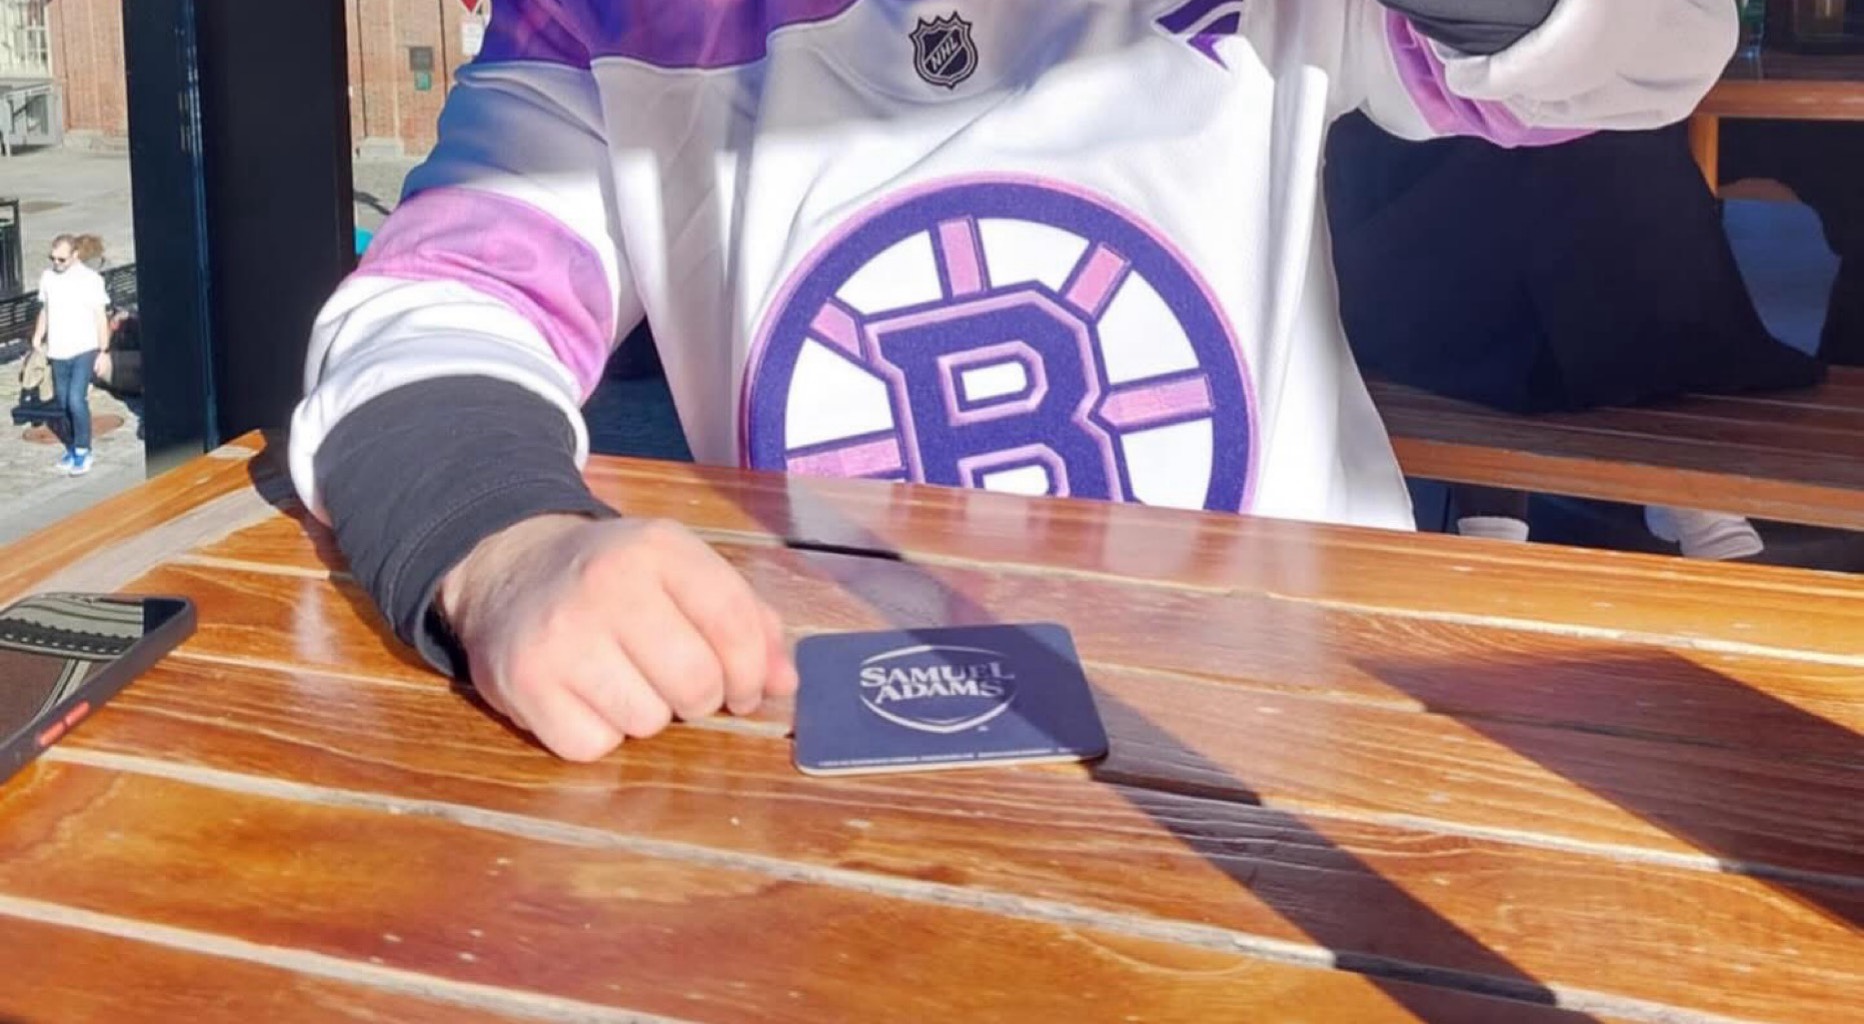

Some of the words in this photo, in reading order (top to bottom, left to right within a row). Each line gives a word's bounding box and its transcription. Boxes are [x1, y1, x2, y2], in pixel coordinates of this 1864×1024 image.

[930, 36, 960, 71] NHL
[866, 283, 1136, 504] B
[859, 662, 1016, 687] SAMUEL
[874, 680, 1005, 705] ADAMS
